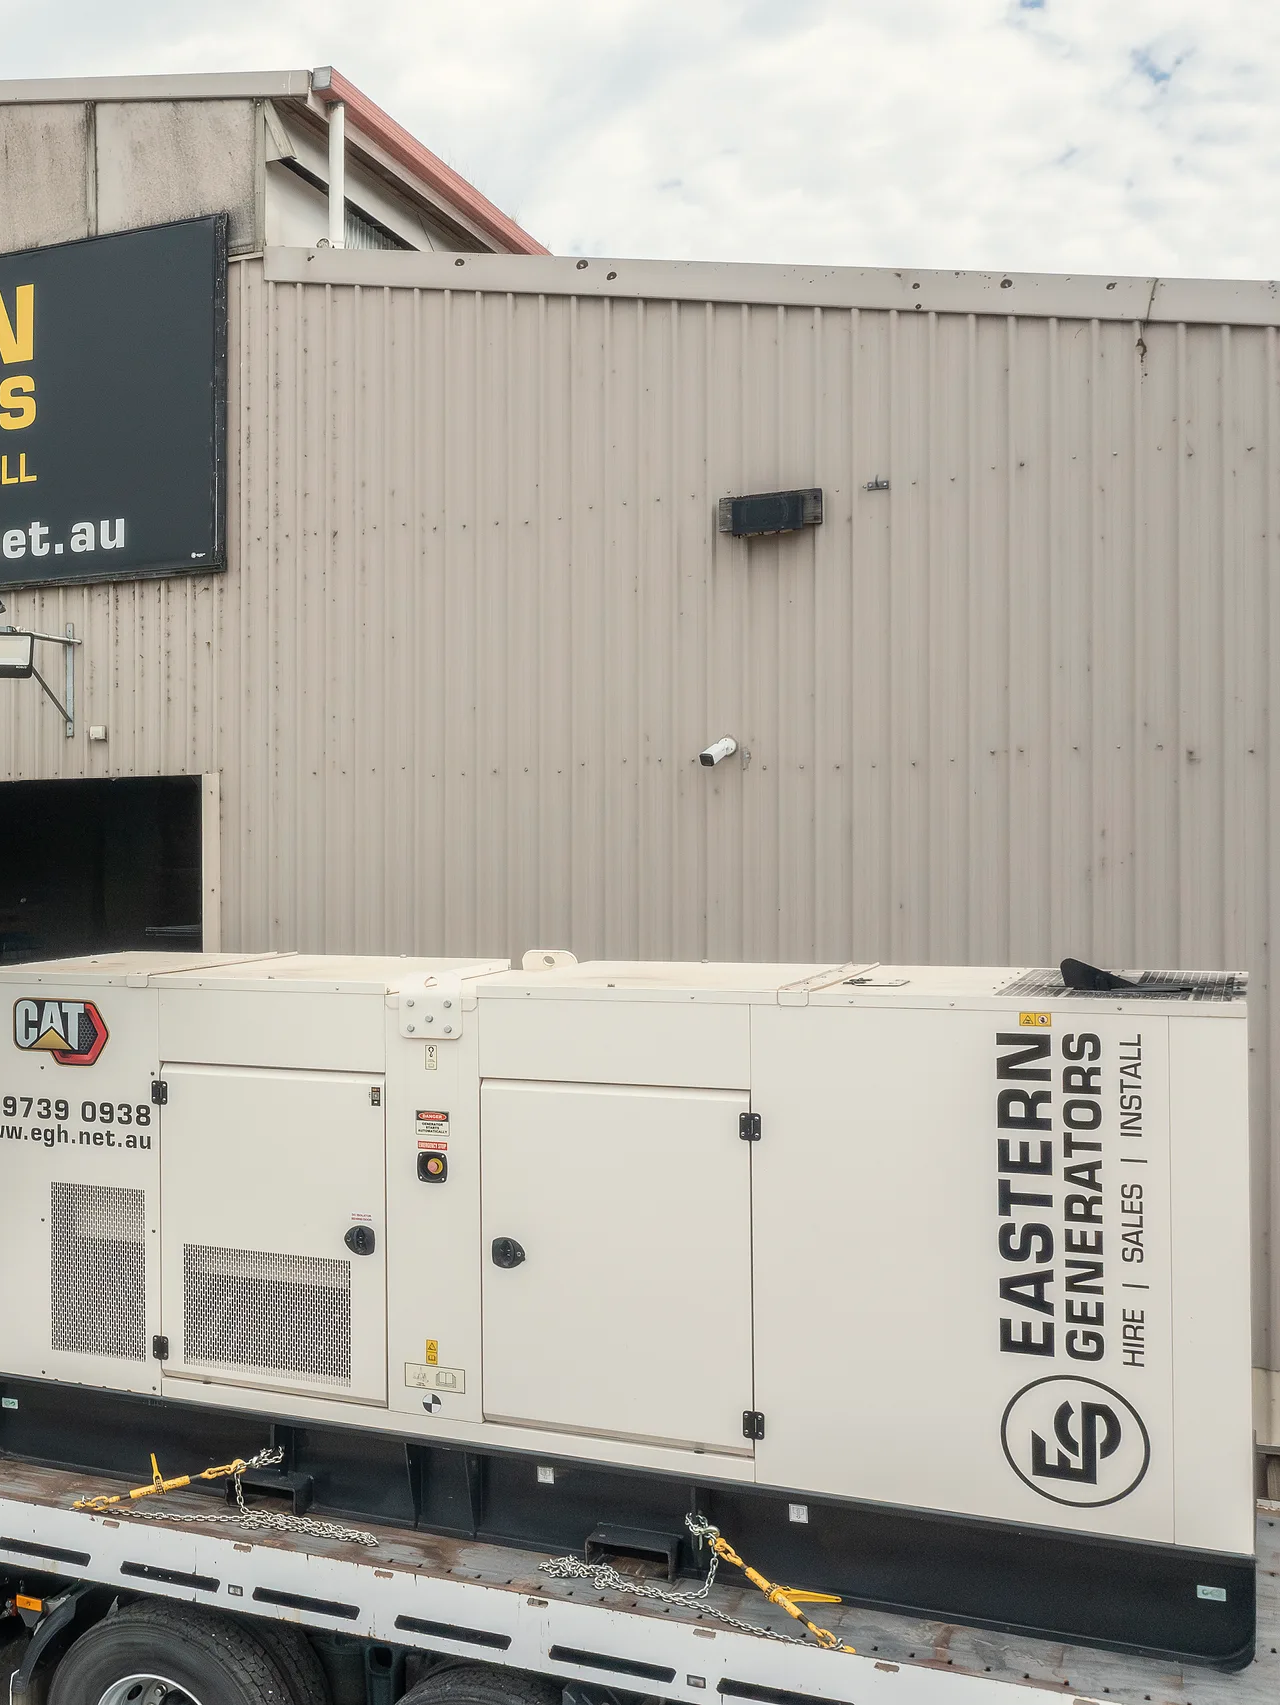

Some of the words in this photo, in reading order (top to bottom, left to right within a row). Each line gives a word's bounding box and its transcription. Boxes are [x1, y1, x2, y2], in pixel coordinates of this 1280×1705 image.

[15, 999, 85, 1051] CAT
[2, 1095, 69, 1121] 9739
[81, 1101, 152, 1127] 0938
[1119, 1033, 1142, 1138] INSTALL
[995, 1032, 1055, 1358] EASTERN
[1061, 1033, 1105, 1362] GENERATORS
[1120, 1183, 1144, 1264] SALES
[1122, 1308, 1145, 1368] HIRE
